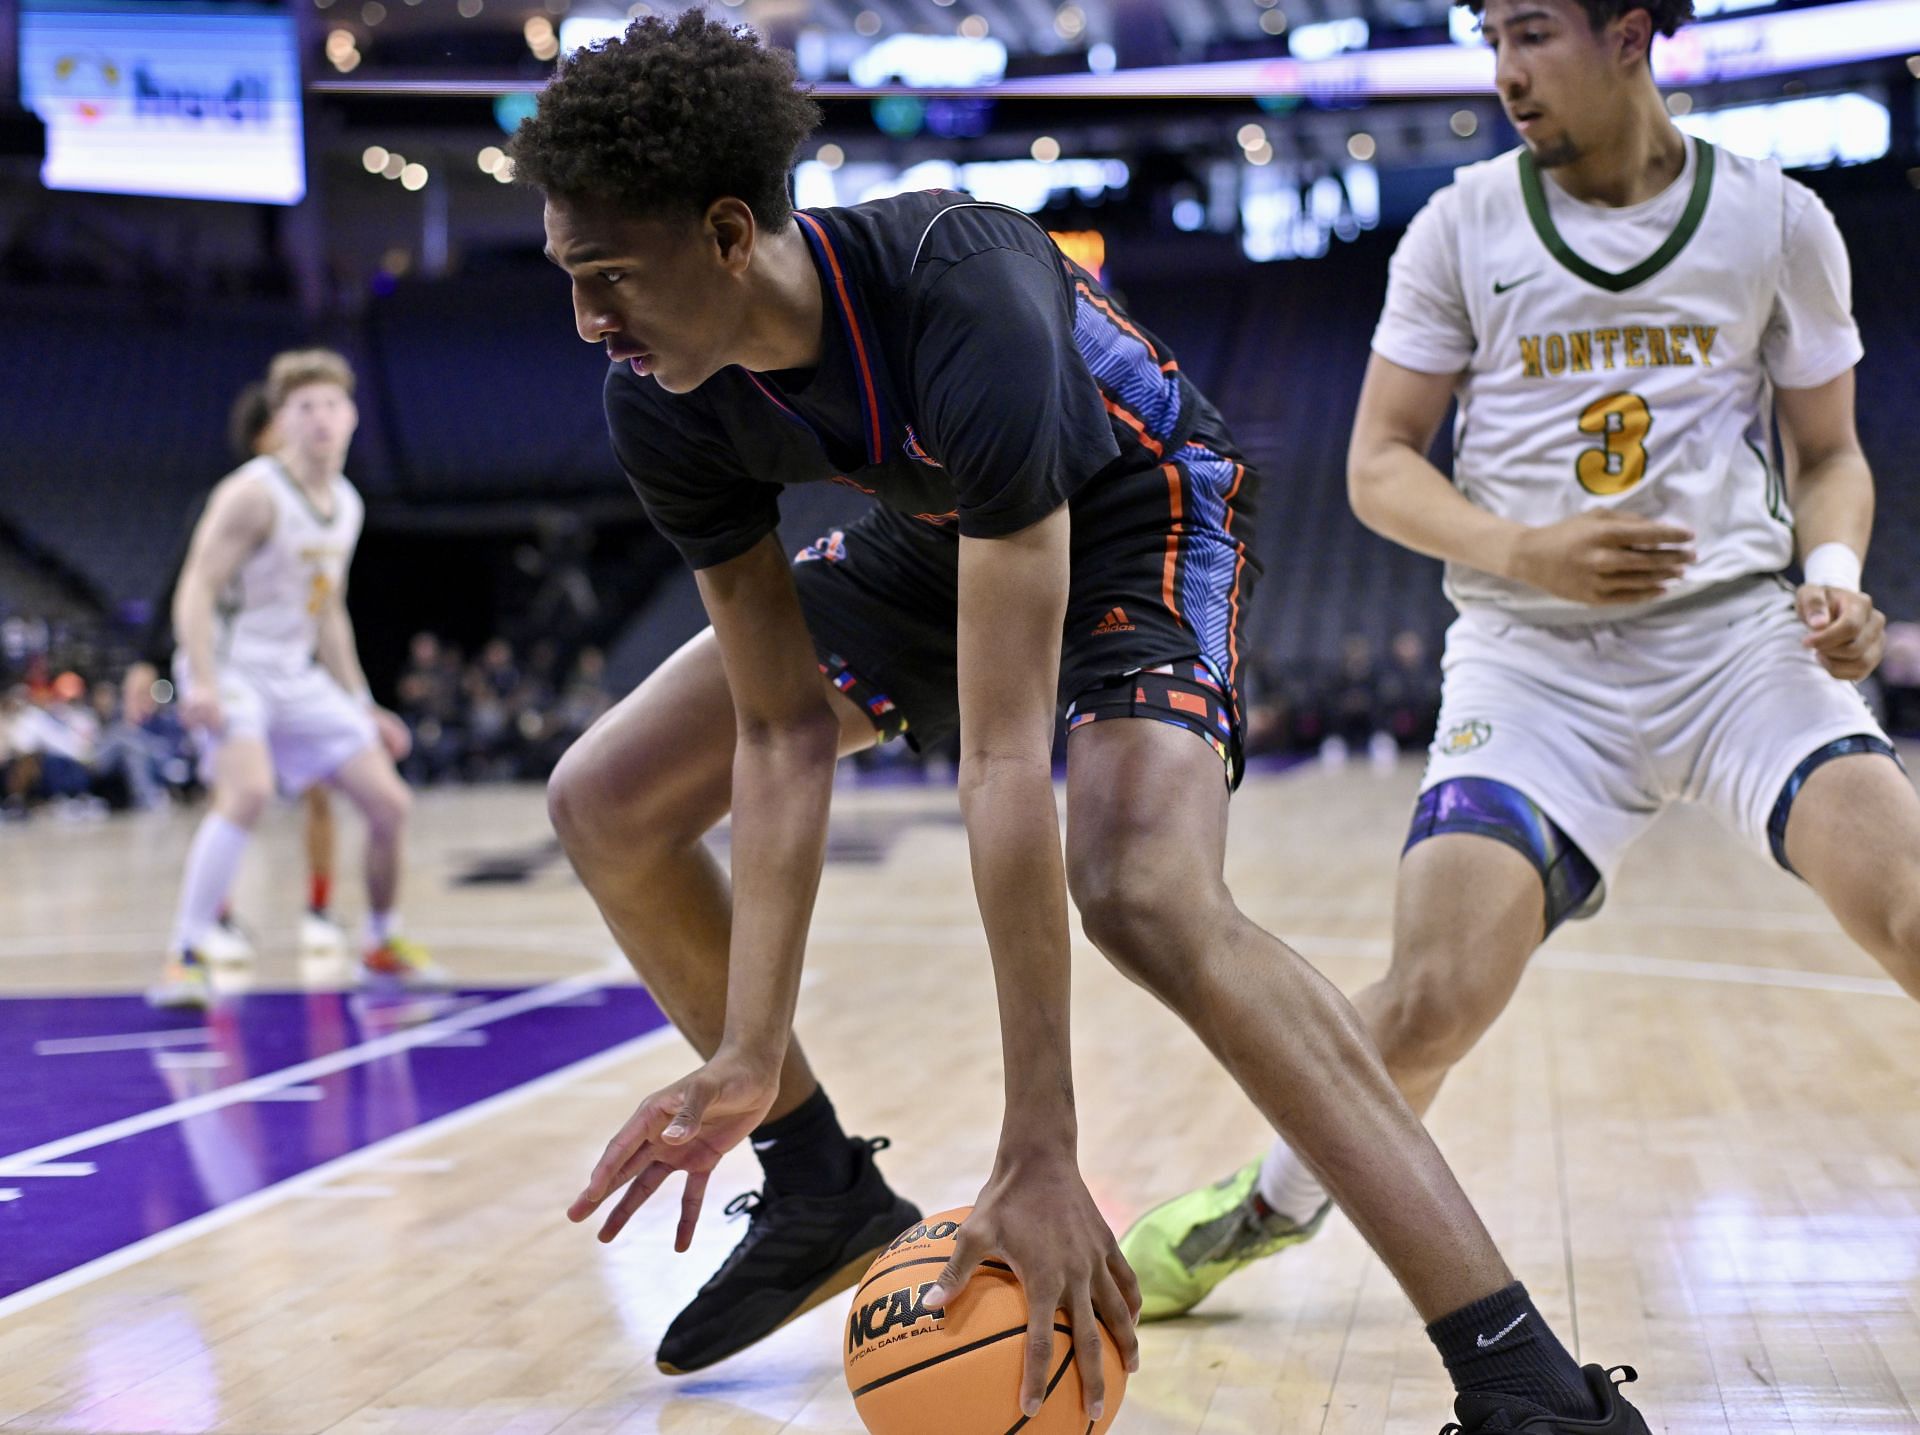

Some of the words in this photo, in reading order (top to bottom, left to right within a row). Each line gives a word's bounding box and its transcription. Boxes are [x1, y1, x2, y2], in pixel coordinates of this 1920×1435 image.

[1519, 324, 1719, 378] MONTEREY
[1575, 390, 1653, 495] 3
[1091, 623, 1137, 636] adidas
[878, 1332, 908, 1349] GAME
[910, 1324, 945, 1338] BALL
